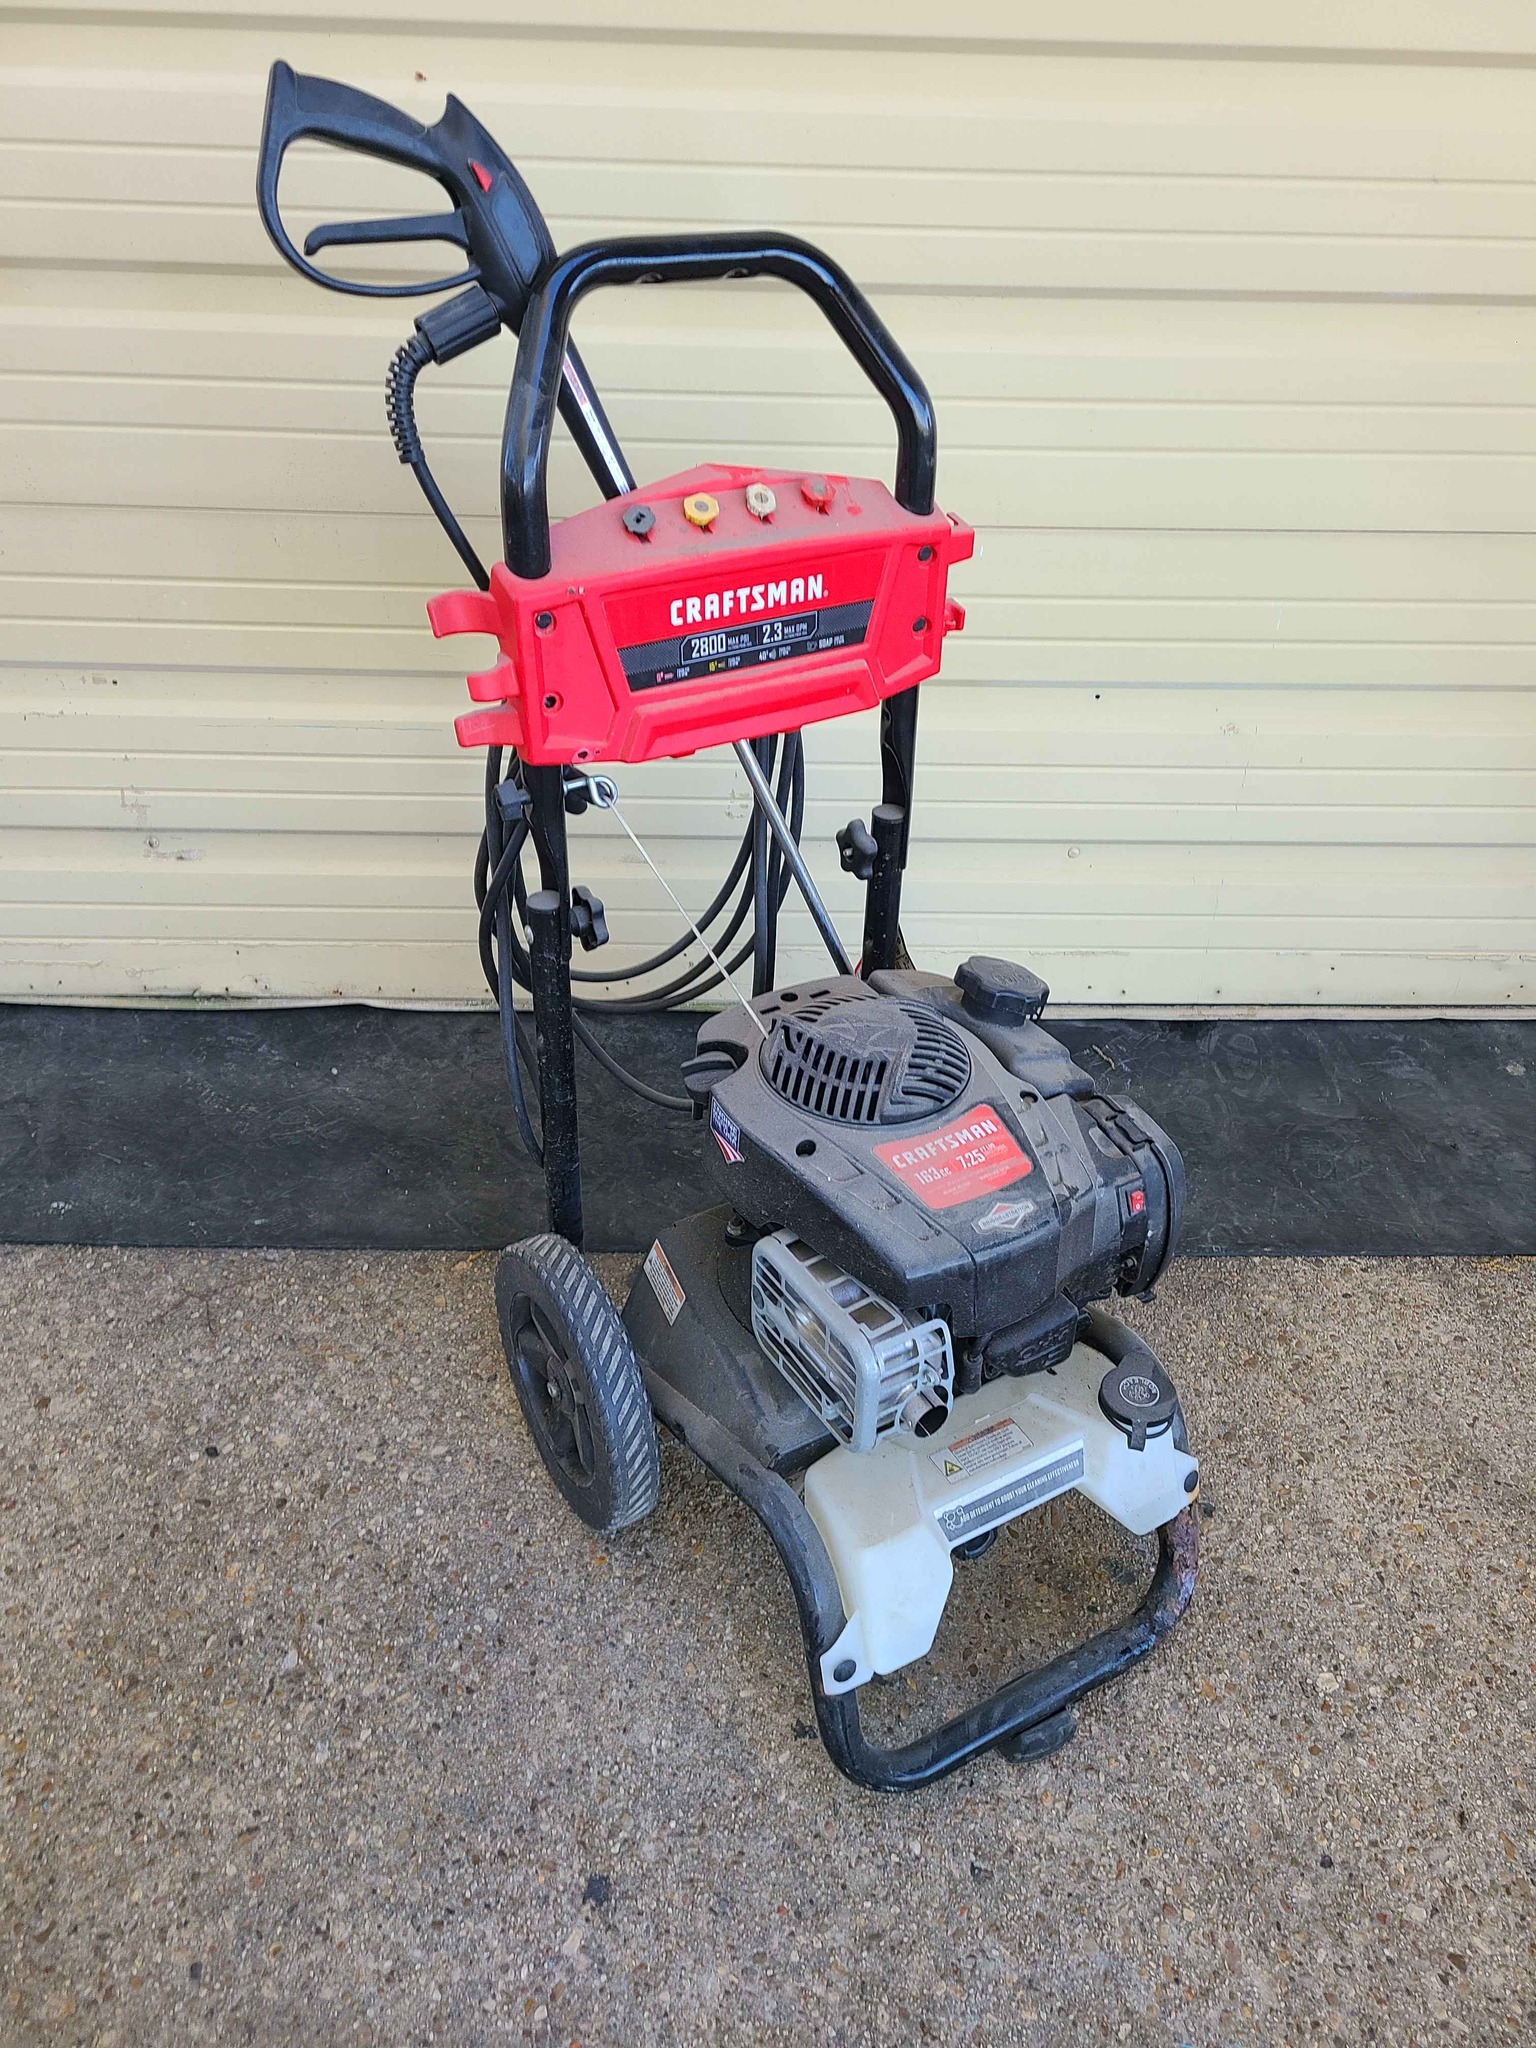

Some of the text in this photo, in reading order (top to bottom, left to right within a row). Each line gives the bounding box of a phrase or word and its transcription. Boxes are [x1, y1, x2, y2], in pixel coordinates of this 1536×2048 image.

[670, 574, 823, 626] CRAFTSMAN
[763, 621, 782, 644] 2.3
[784, 625, 795, 635] MAX
[691, 633, 726, 659] 2800
[728, 636, 739, 646] MAX
[892, 1119, 998, 1169] CRAFTSMAN
[956, 1149, 986, 1169] 7.25
